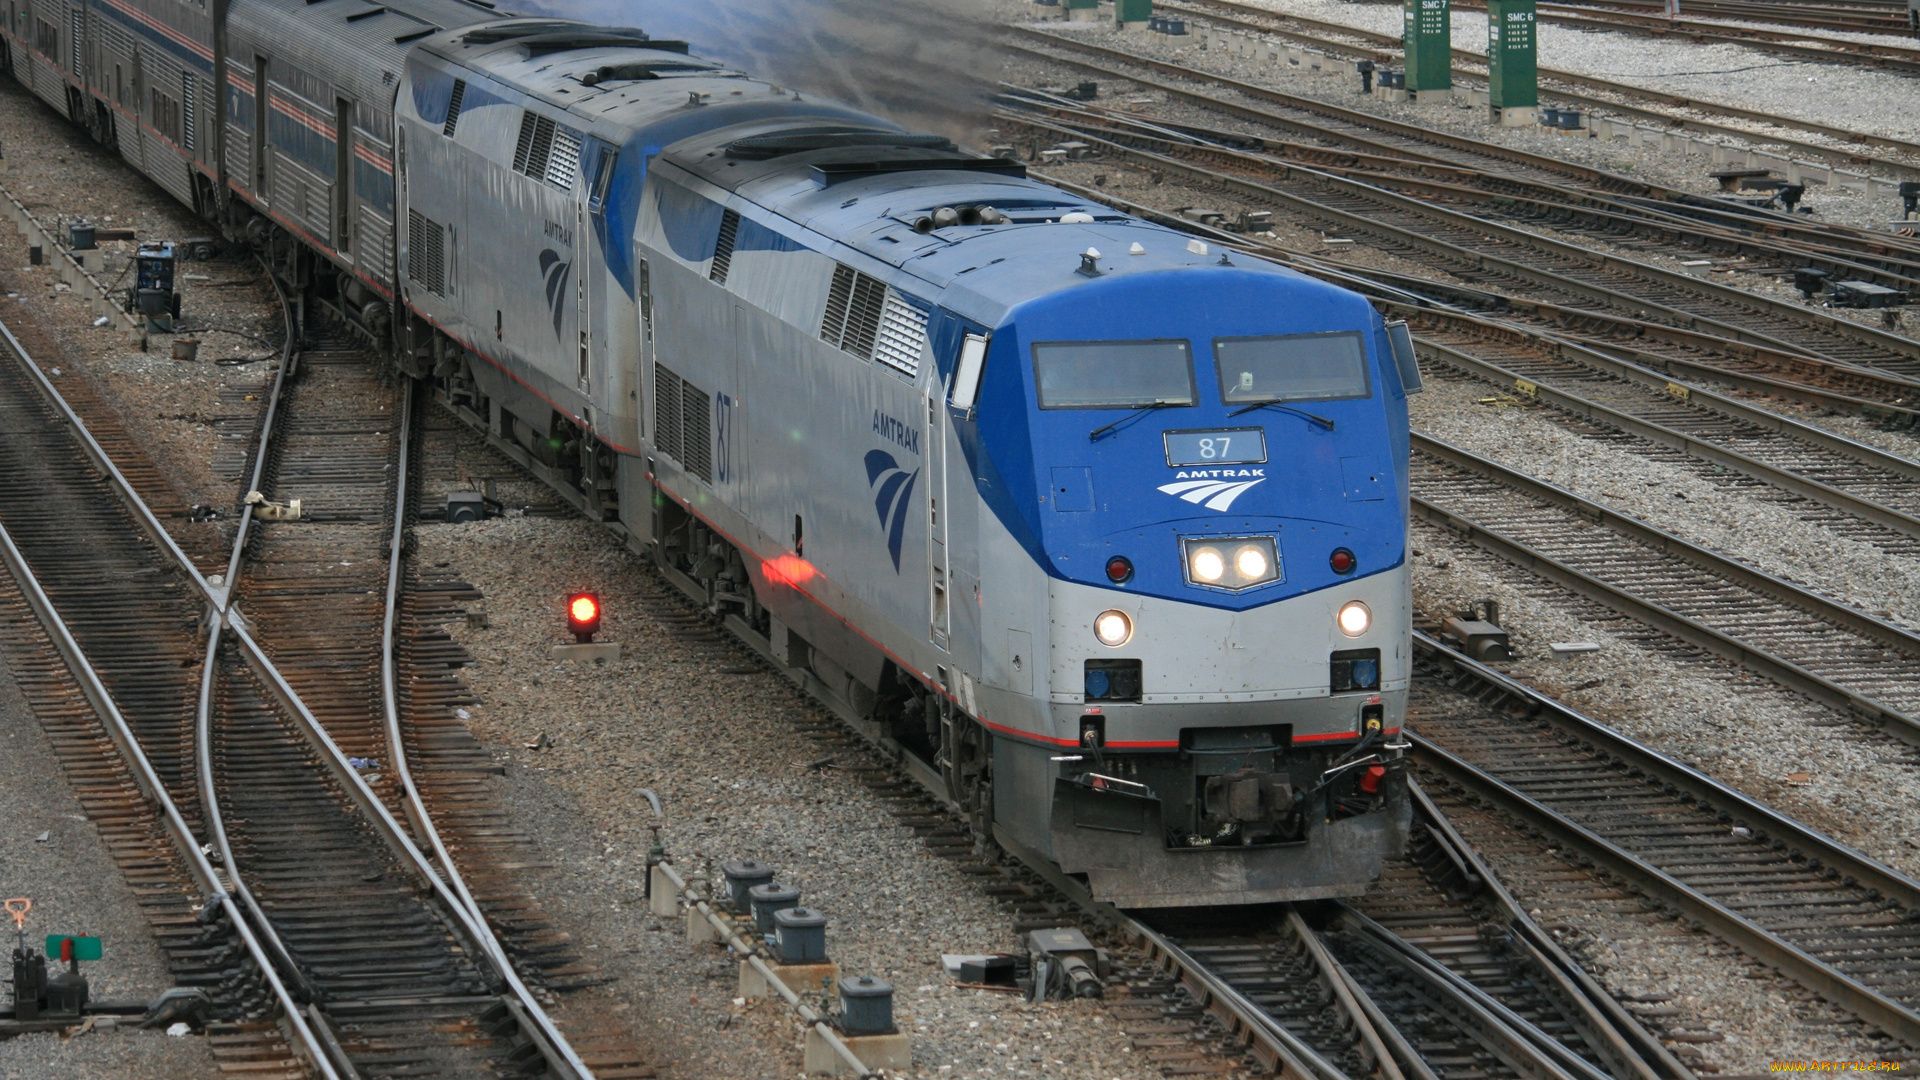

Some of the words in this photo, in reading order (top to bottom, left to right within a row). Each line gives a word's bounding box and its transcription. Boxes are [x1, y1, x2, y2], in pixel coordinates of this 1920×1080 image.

[1422, 0, 1440, 9] SMC
[1441, 0, 1447, 9] 7
[1507, 12, 1526, 22] SMC
[1527, 12, 1534, 22] 6
[544, 218, 572, 249] AMTRAK
[448, 222, 459, 298] 21
[716, 391, 731, 485] 87
[872, 408, 919, 456] AMTRAK
[1198, 437, 1231, 459] 87
[1175, 469, 1265, 479] AMTRAK
